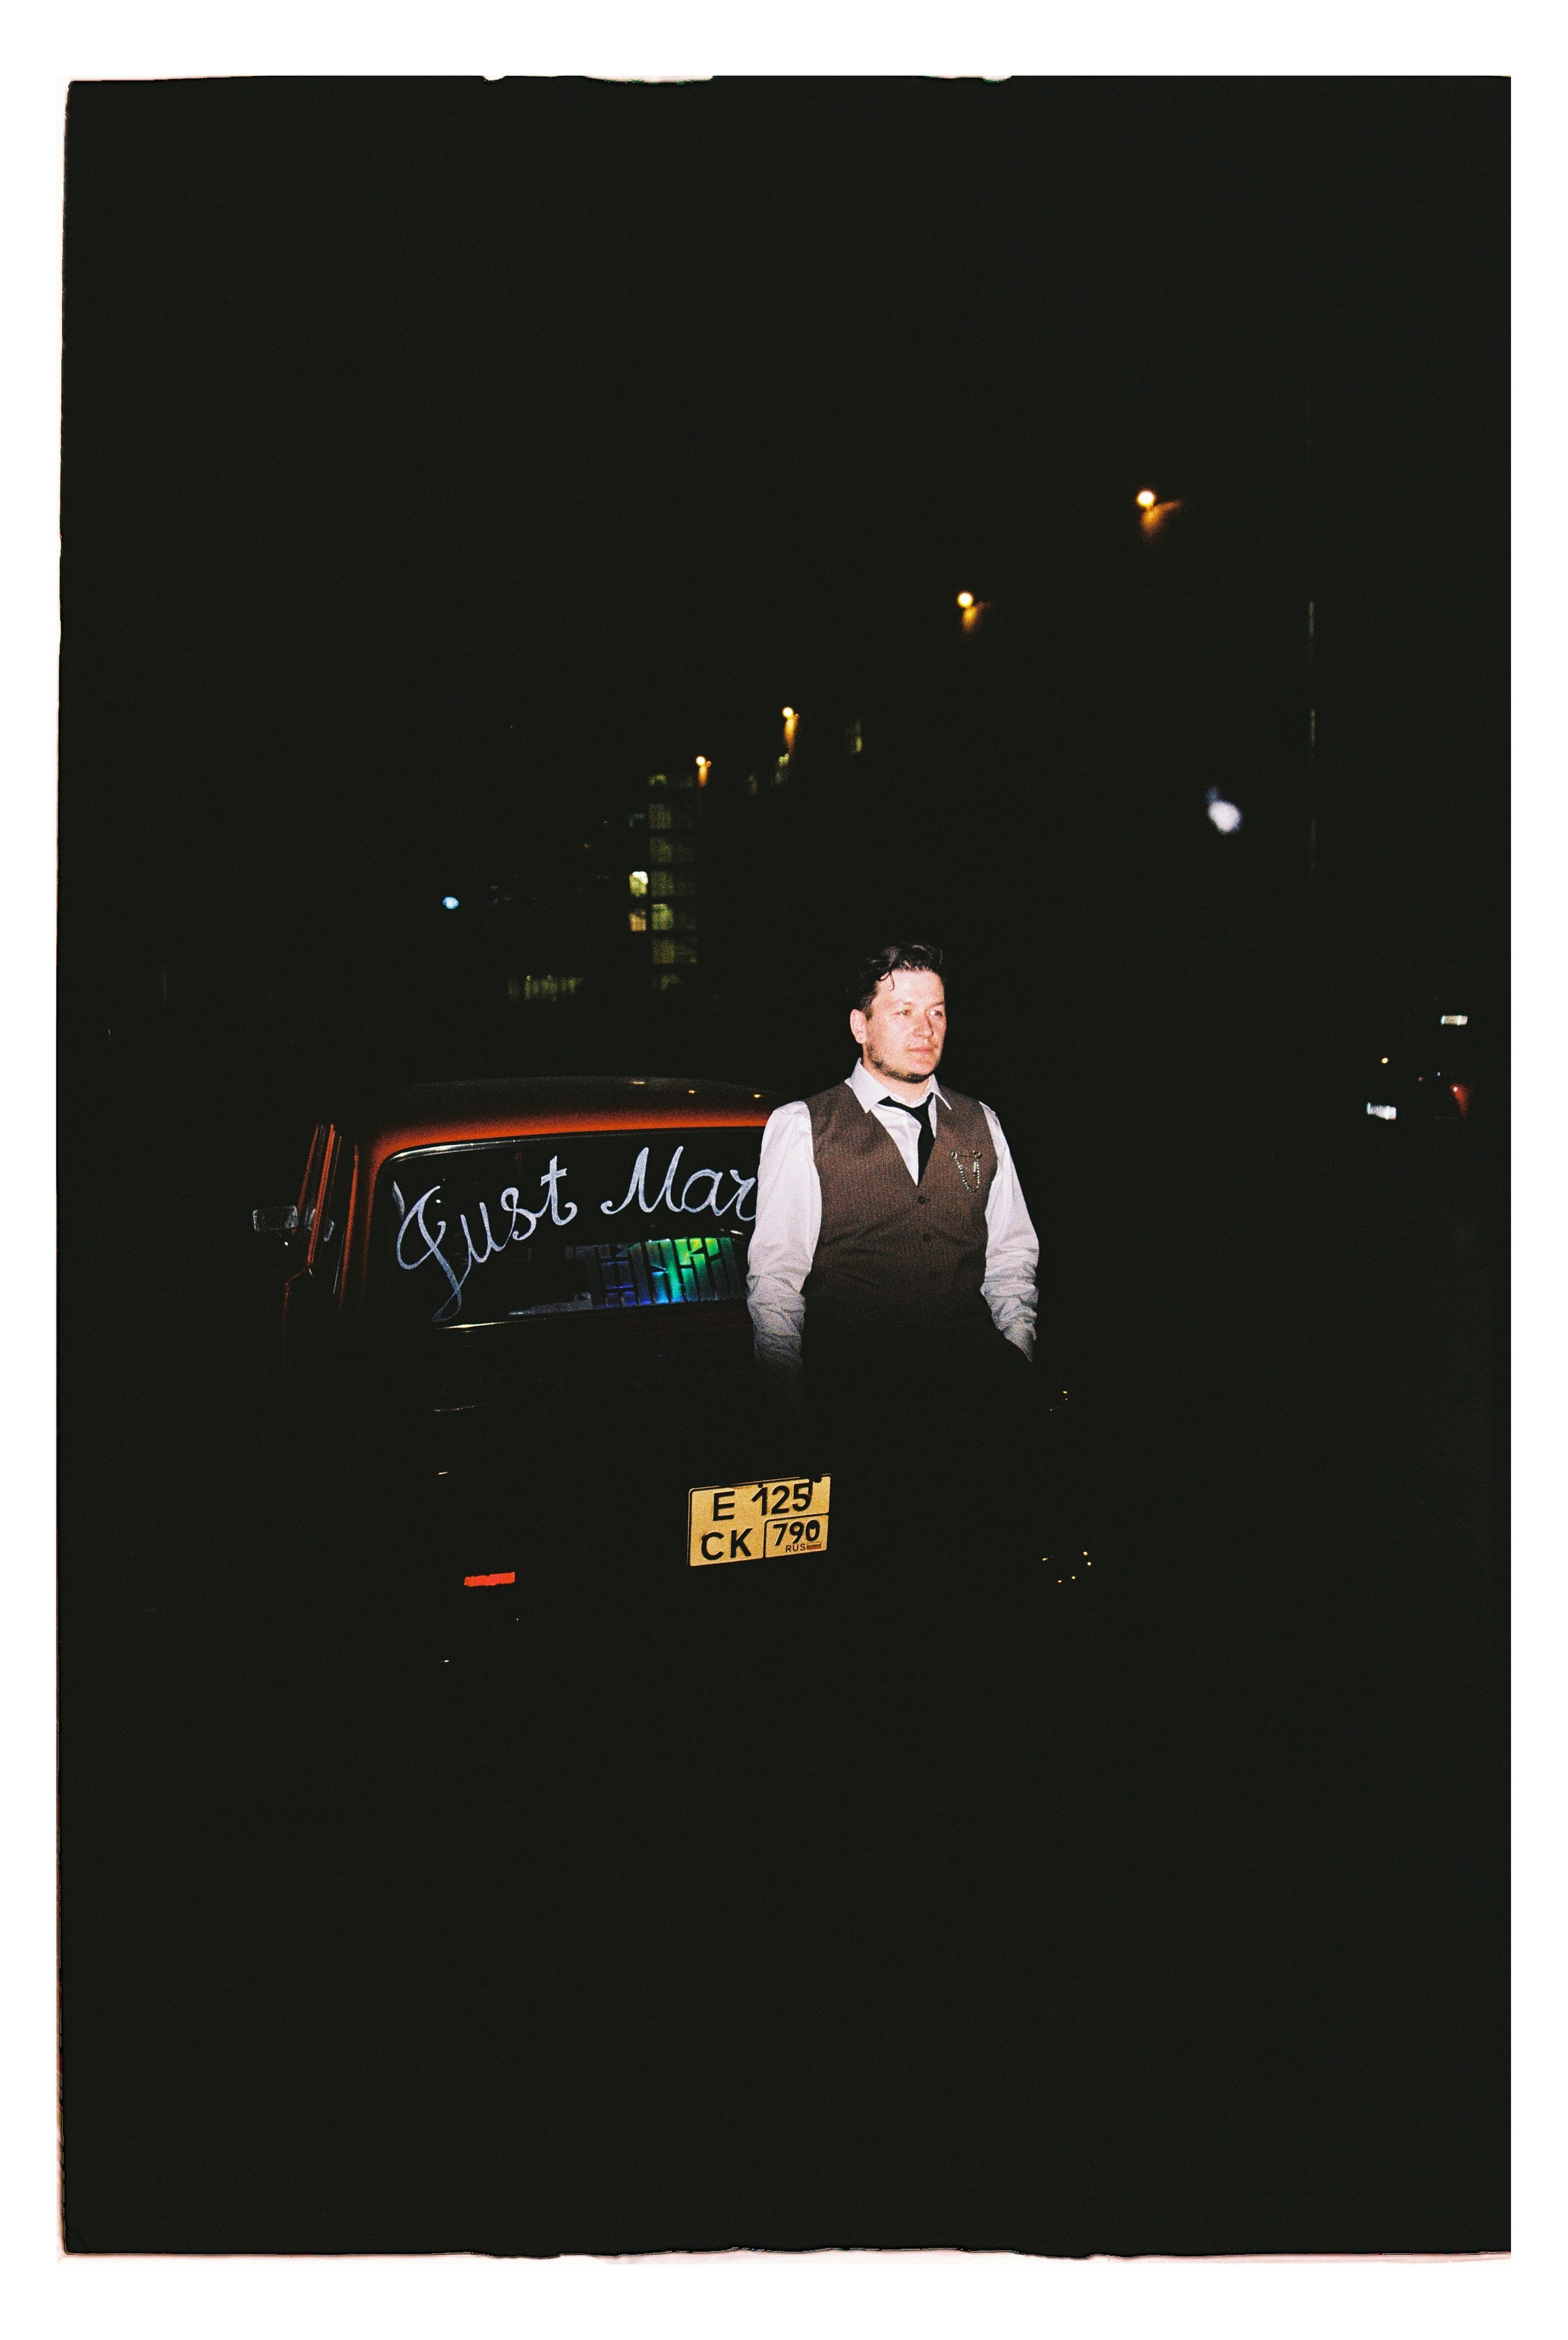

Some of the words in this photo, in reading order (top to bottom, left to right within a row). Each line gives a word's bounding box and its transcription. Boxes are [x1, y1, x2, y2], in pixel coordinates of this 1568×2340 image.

[396, 1155, 578, 1323] Just
[713, 1491, 735, 1521] E
[752, 1482, 813, 1516] 125
[701, 1528, 753, 1560] CK
[773, 1520, 820, 1546] 790
[785, 1543, 806, 1553] RUS
